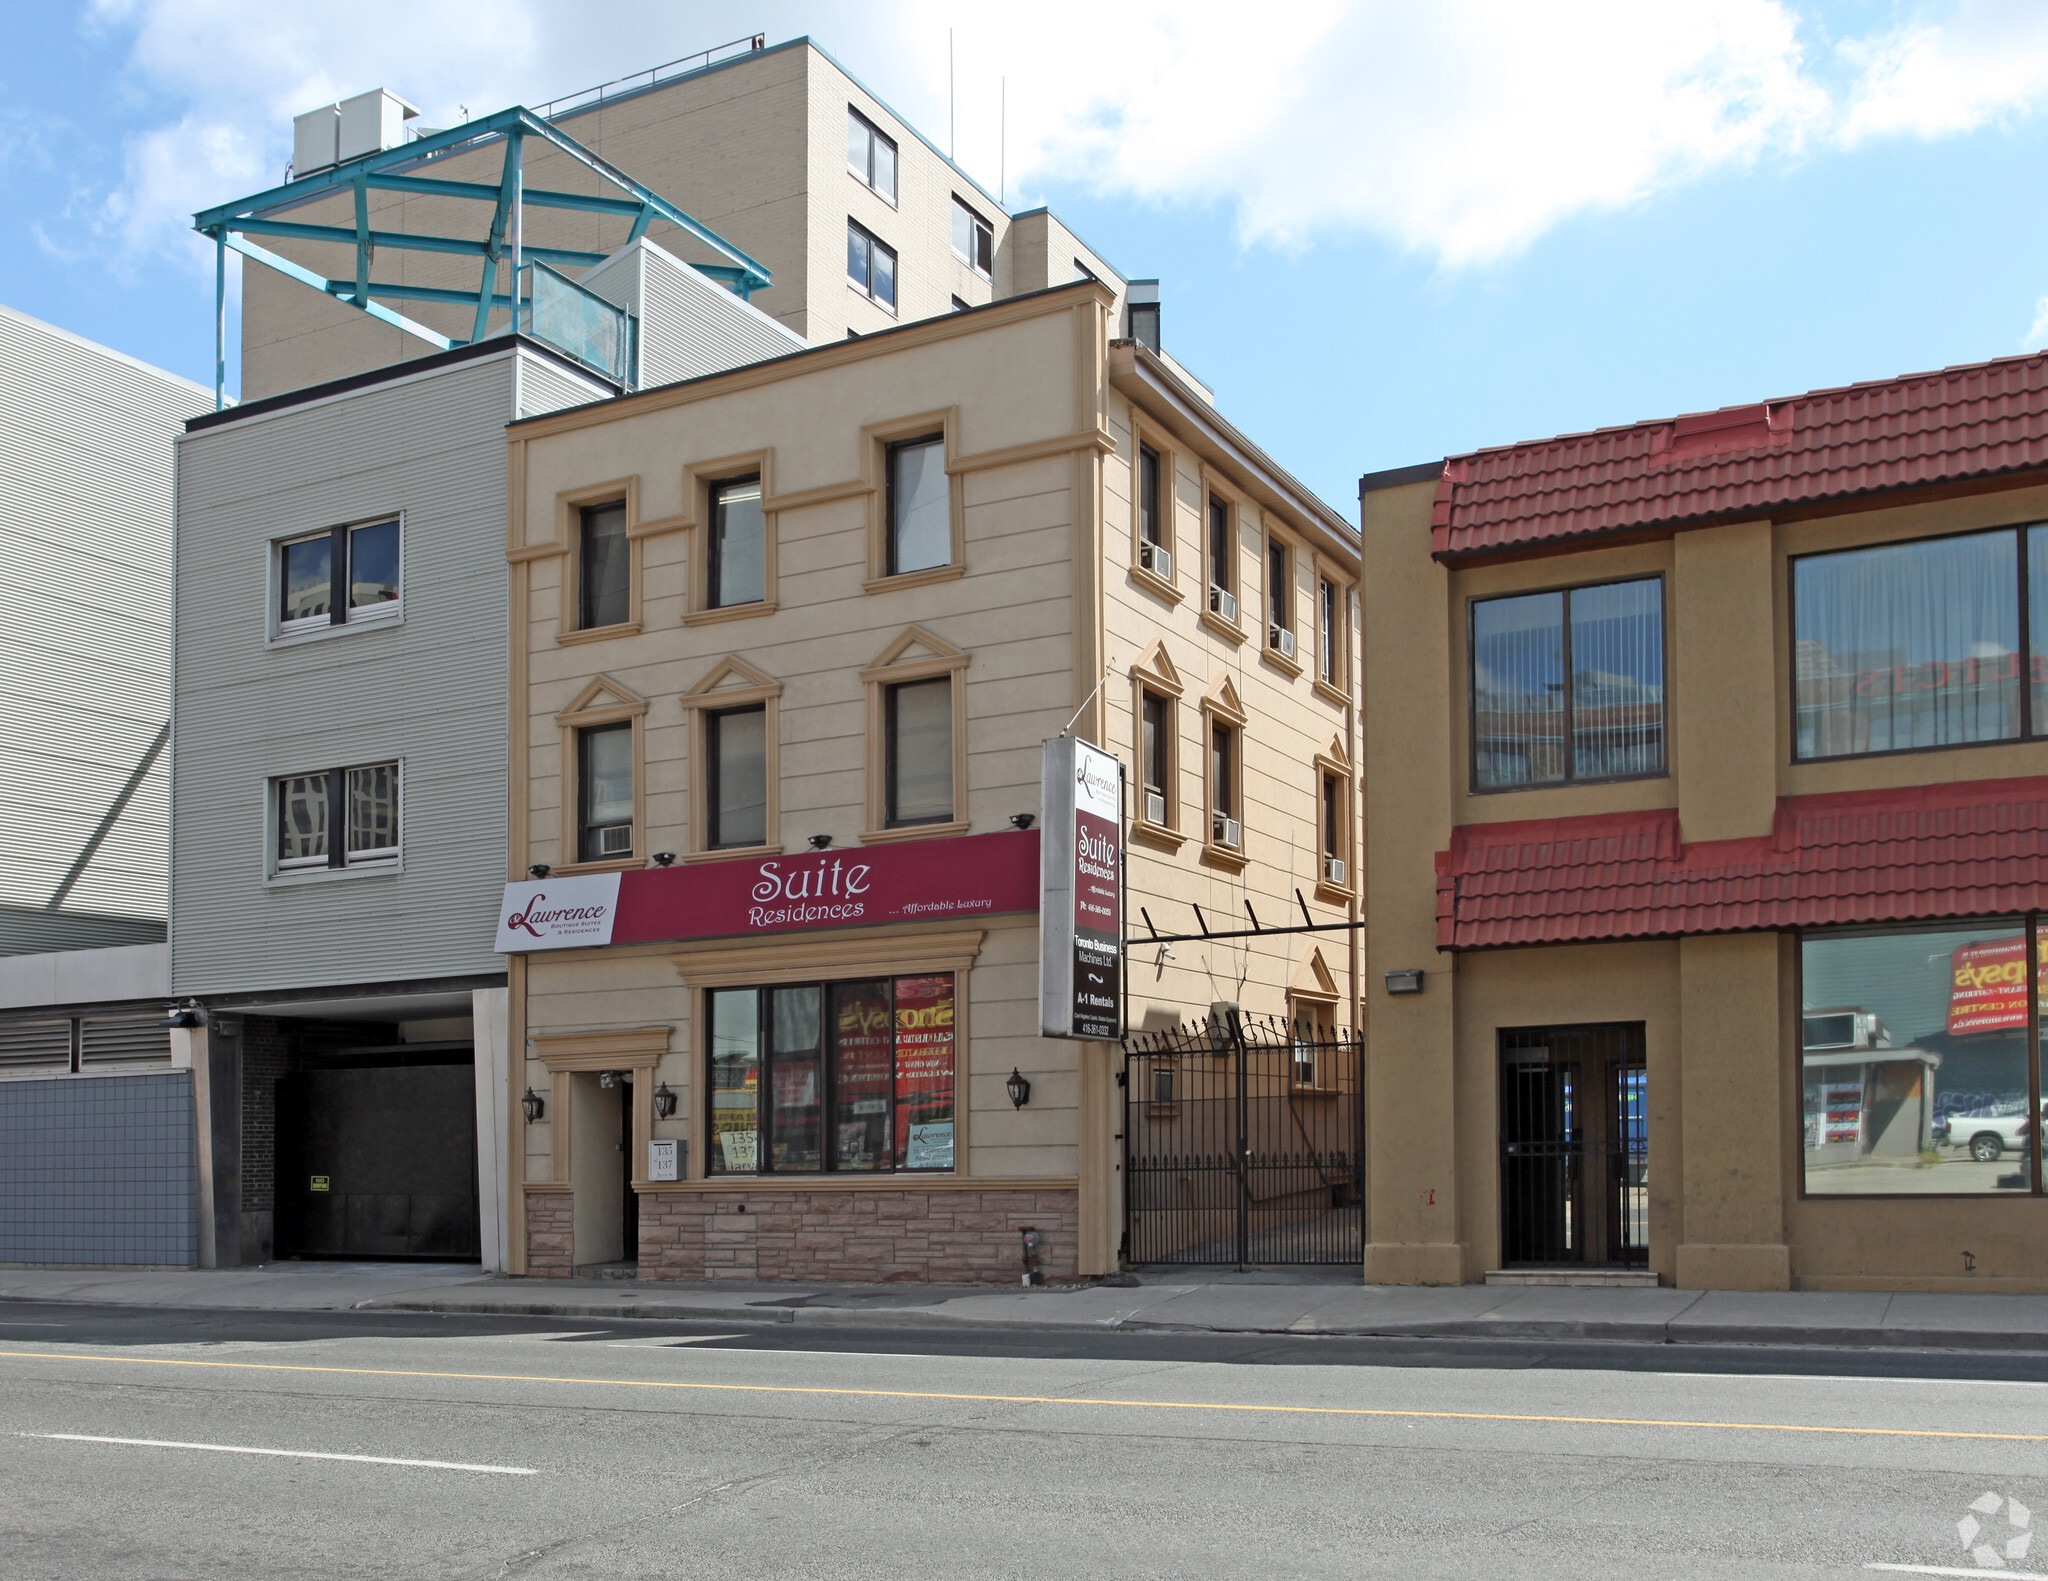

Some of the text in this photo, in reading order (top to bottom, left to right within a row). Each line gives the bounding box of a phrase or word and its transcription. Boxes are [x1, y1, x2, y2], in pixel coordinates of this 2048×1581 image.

[1077, 755, 1116, 798] Lawrence
[1079, 825, 1115, 867] Suite
[1079, 857, 1114, 881] Residences
[752, 858, 871, 902] Suite
[508, 894, 606, 937] Lawrence
[749, 902, 865, 926] Residences
[903, 901, 954, 914] Affordable
[957, 899, 992, 909] Luxury
[550, 921, 579, 929] BOUTIQUE
[1075, 935, 1117, 954] Toronto Business
[1079, 951, 1113, 967] Machines Ltd.
[1077, 992, 1113, 1008] A-1 Rentals
[913, 1127, 952, 1144] Lawrence
[658, 1146, 672, 1156] 135
[732, 1146, 755, 1158] 137
